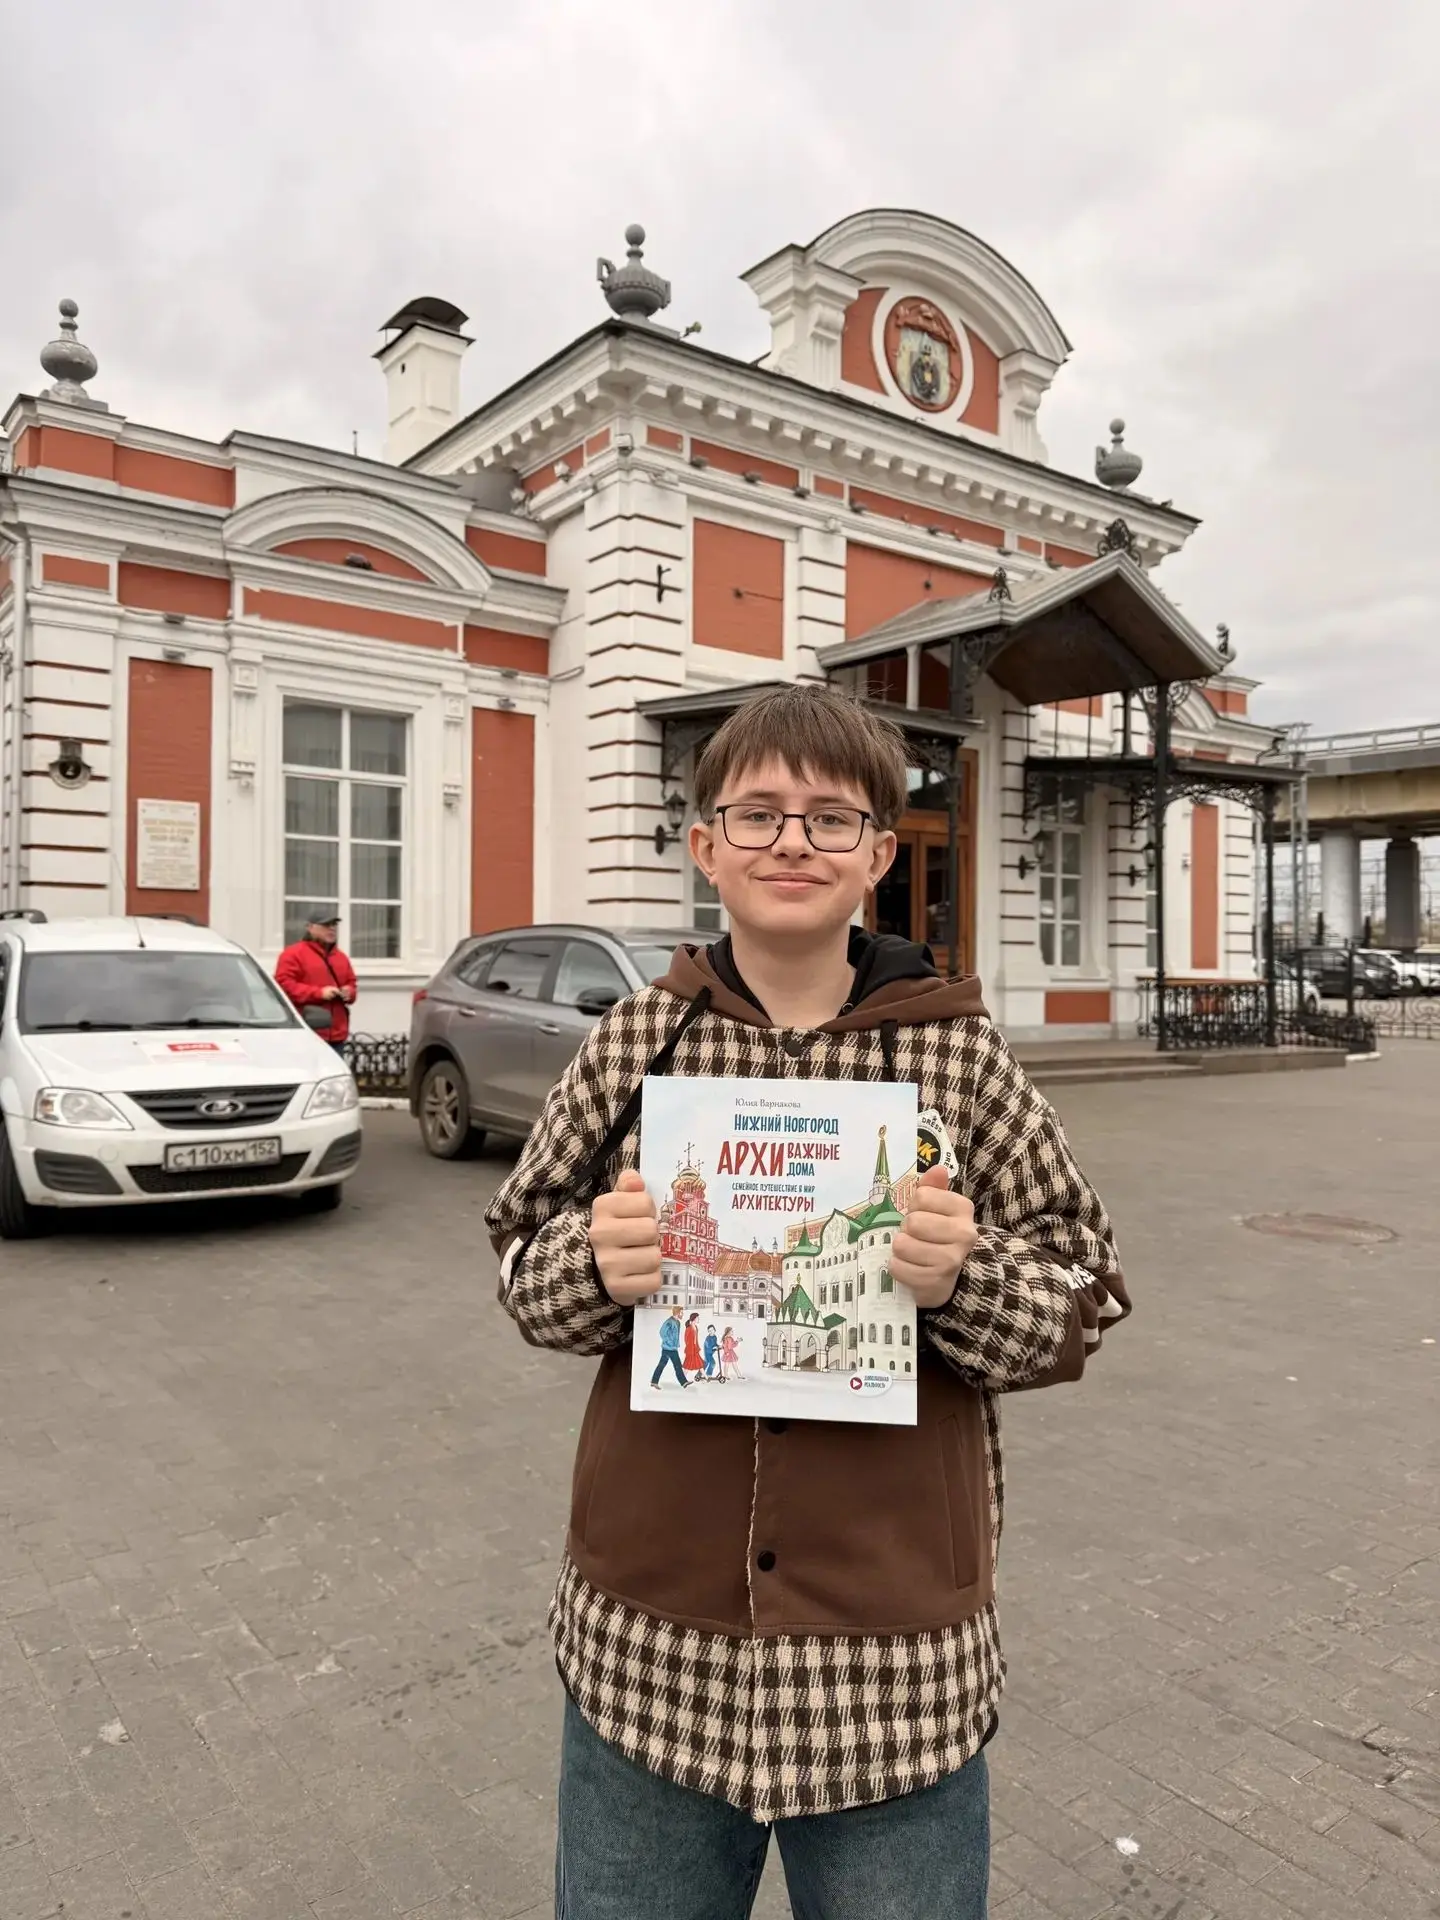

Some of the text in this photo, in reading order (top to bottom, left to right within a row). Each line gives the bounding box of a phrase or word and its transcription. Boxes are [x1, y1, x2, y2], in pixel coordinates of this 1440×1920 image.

[735, 1097, 801, 1109] Юлия Варнакова
[734, 1113, 839, 1135] НИЖНИЙ НОВГОРОД
[921, 1117, 943, 1133] DRESS
[250, 1141, 276, 1156] 152
[717, 1140, 840, 1177] АРХИ ВАЖНЫЕ
[943, 1151, 952, 1168] DRE
[786, 1162, 815, 1177] ДОМА
[732, 1181, 816, 1193] СЕМЕЙНОЕ ПУТЕШЕСТВИЕ В МИР
[731, 1194, 814, 1212] АРХИТЕКТУРЫ
